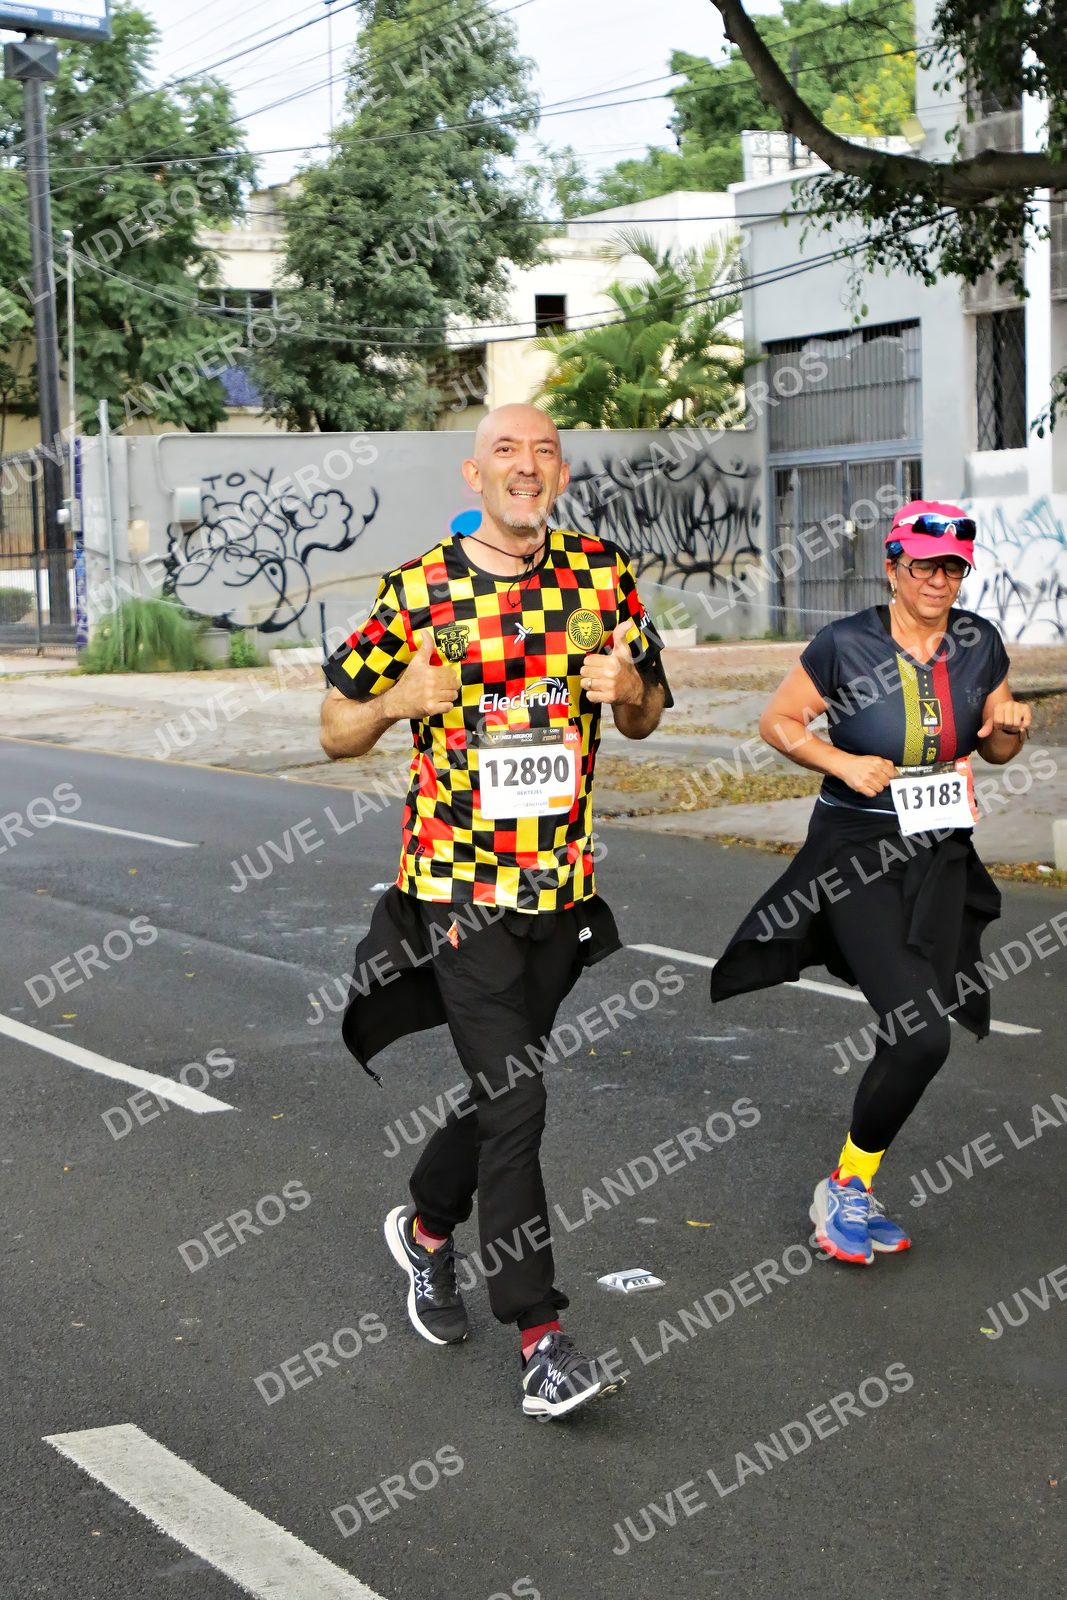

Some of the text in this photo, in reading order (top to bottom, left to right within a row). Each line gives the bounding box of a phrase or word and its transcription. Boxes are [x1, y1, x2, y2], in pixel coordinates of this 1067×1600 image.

[202, 468, 274, 495] TOY
[479, 687, 571, 713] Electrolit
[485, 755, 569, 787] 12890
[897, 781, 961, 810] 13183
